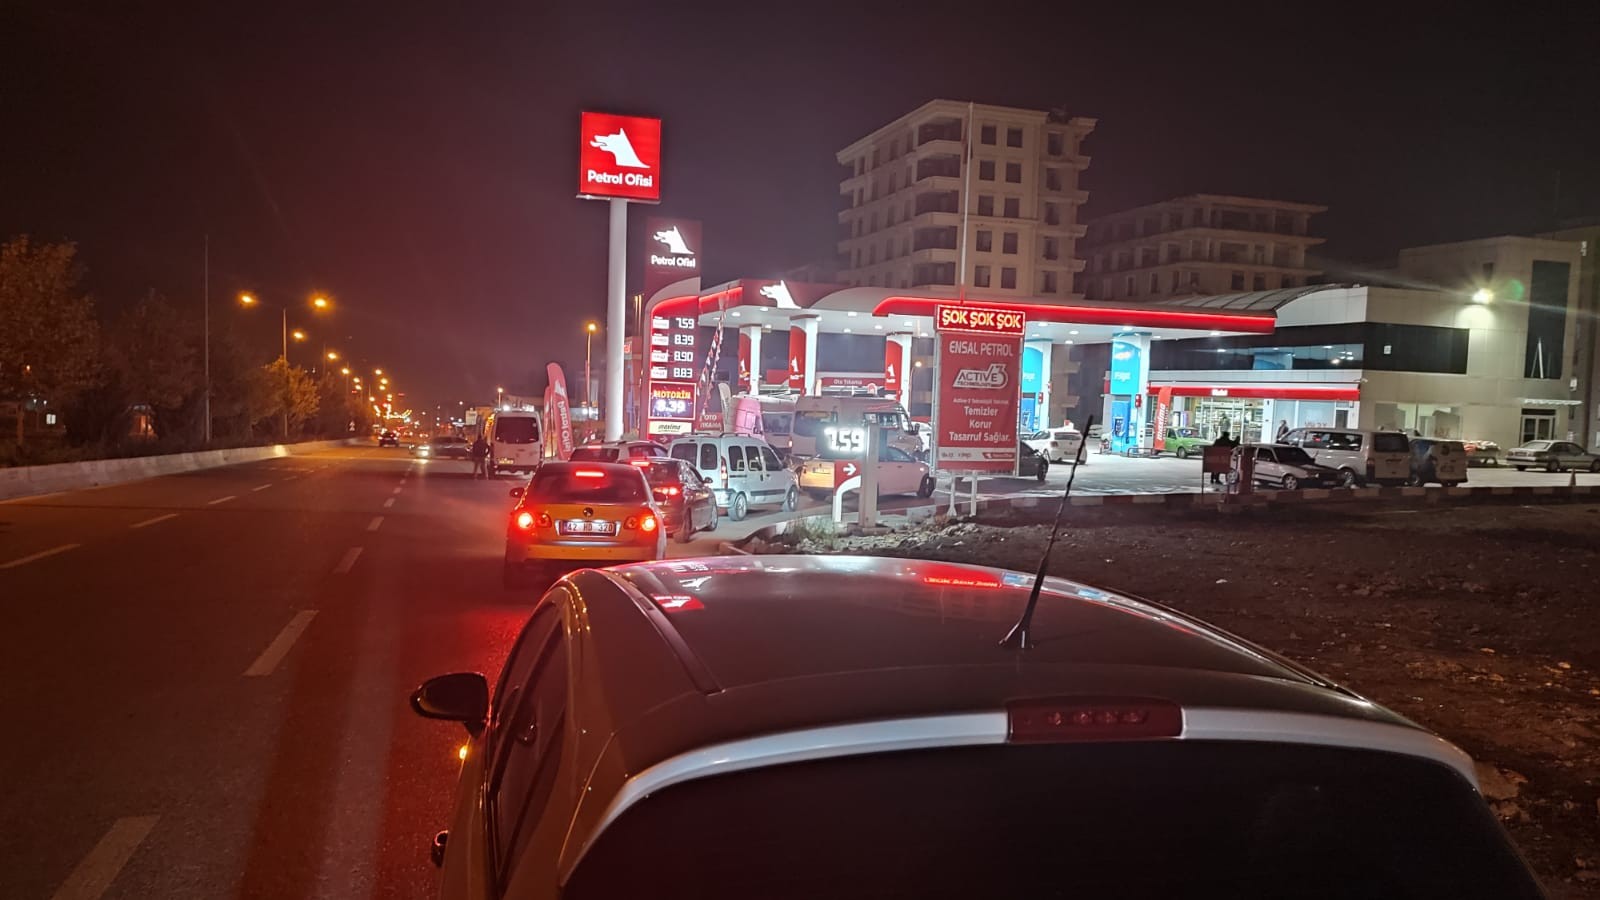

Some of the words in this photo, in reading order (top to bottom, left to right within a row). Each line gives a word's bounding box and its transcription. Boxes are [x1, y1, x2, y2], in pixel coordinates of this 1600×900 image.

[587, 169, 622, 185] Petrol
[625, 172, 653, 188] Ofisi
[651, 254, 676, 267] Petrol
[942, 309, 968, 326] ŞOK
[969, 311, 995, 328] ŞOK
[996, 313, 1022, 330] ŞOK
[949, 340, 978, 355] ENSAL
[980, 342, 1014, 357] PETROL
[958, 366, 998, 383] ACTIVE
[964, 406, 999, 416] Temizler
[969, 419, 992, 429] Korur
[949, 431, 982, 441] Tasarruf
